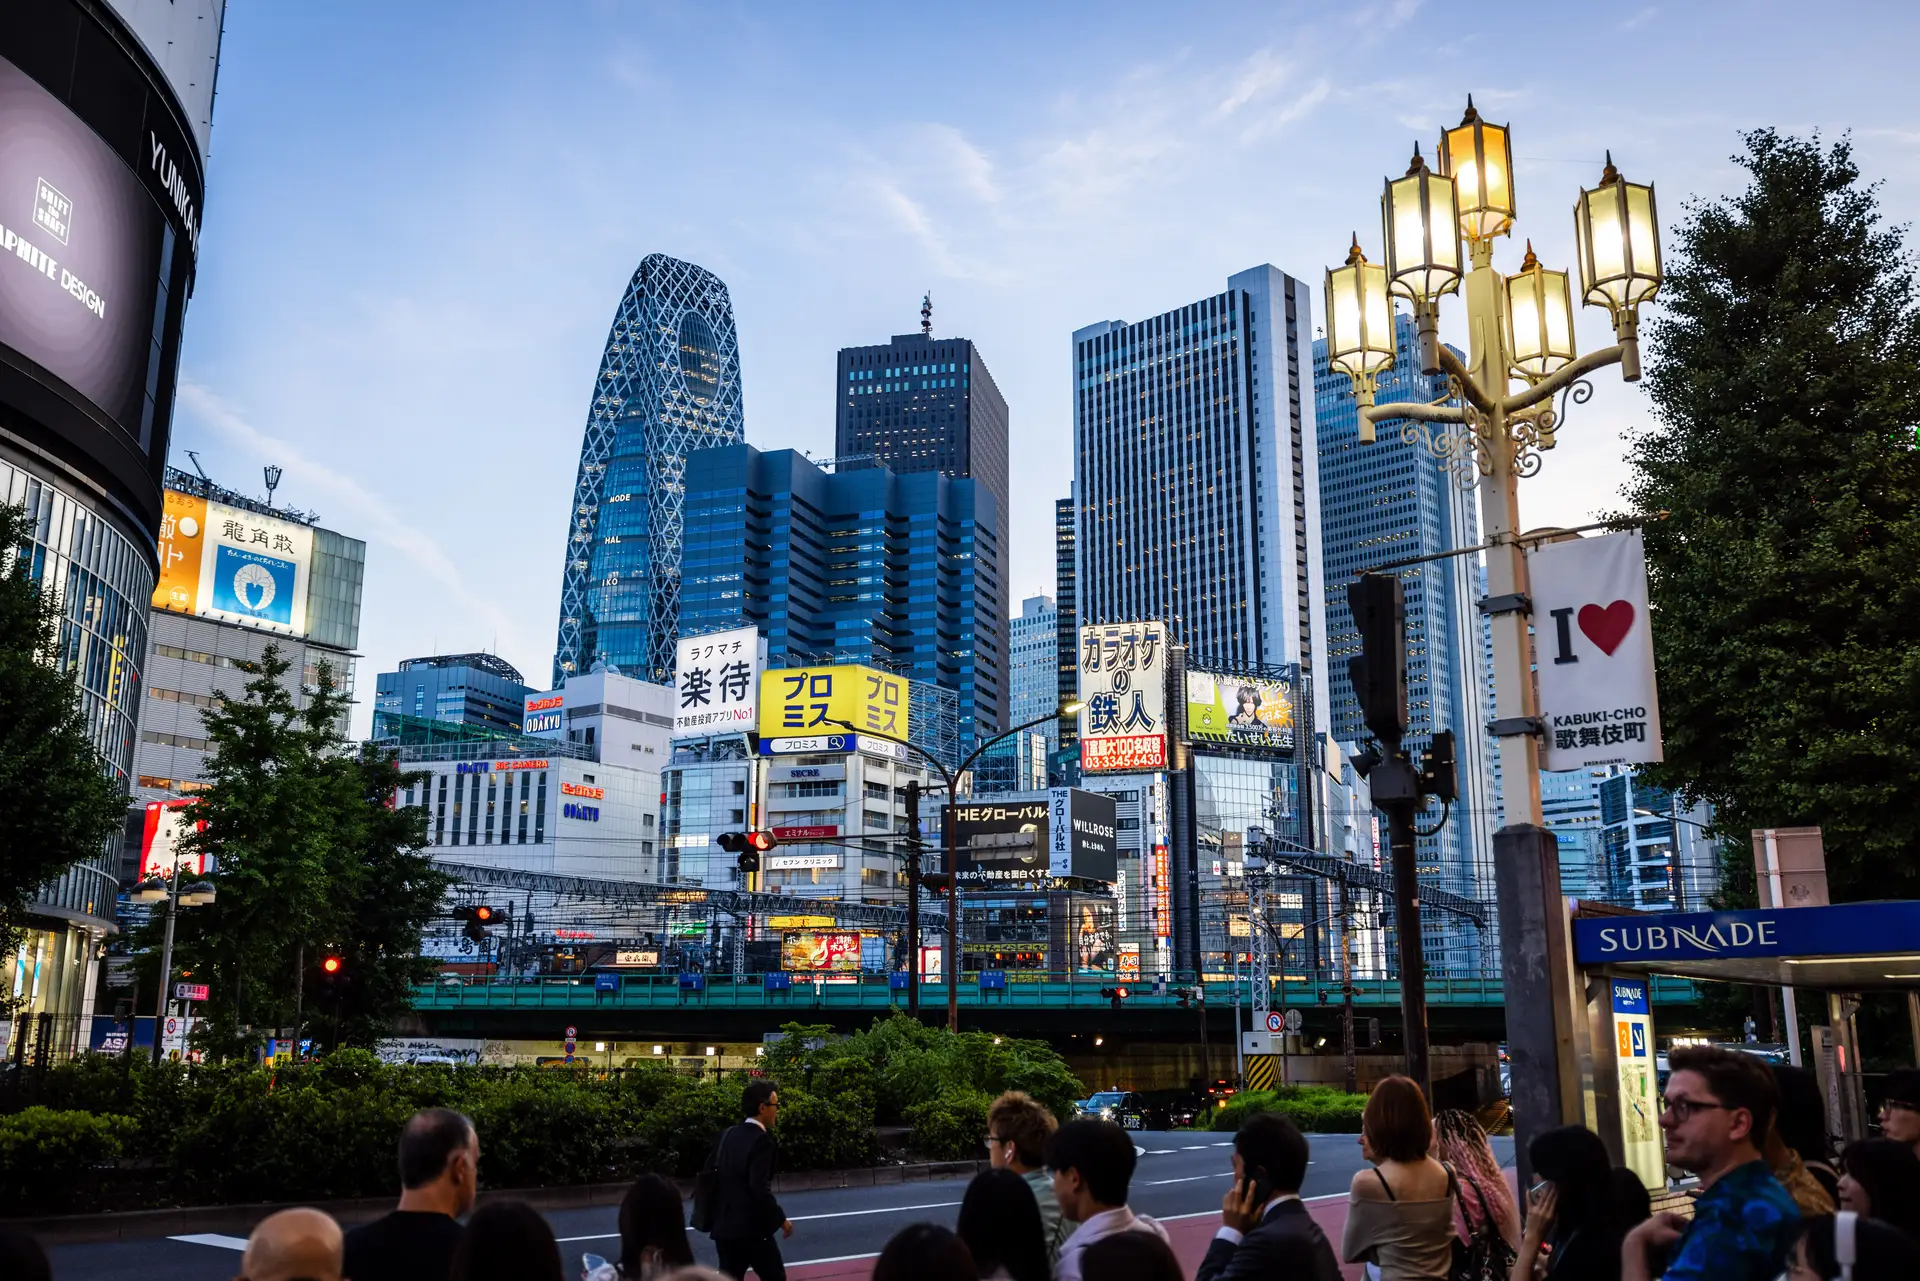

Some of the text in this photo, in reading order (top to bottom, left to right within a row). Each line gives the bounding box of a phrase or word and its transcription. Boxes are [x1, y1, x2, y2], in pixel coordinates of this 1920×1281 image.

[40, 185, 69, 216] SHIFT
[37, 207, 66, 238] SHAFT
[60, 267, 106, 319] DESIGN
[609, 493, 631, 503] MODE
[222, 519, 295, 555] 龍角散
[604, 535, 621, 545] HAL
[1550, 606, 1579, 665] I
[690, 640, 742, 661] ラクマチ
[1081, 623, 1161, 674] カラオケ
[680, 659, 751, 709] 楽待
[783, 671, 833, 701] プロ
[866, 675, 899, 707] プロ
[1111, 667, 1132, 696] の
[525, 695, 564, 713] ビックカメラ
[1087, 689, 1156, 735] 鉄人
[526, 713, 561, 733] ODAKYU
[783, 703, 833, 729] ミス
[866, 704, 898, 735] ミス
[1553, 706, 1647, 728] KABUKI-CHO
[784, 739, 818, 750] プロミス
[1226, 730, 1294, 748] たいせい先生
[1555, 721, 1647, 751] 歌舞伎町
[867, 740, 889, 754] プロミス
[456, 761, 489, 774] ODAKYU
[495, 759, 549, 771] BIC CAMERA
[1085, 753, 1162, 769] 03-3345-6430
[790, 768, 820, 778] SECRE
[561, 782, 605, 801] ビックカメラ
[563, 802, 600, 823] ODAKYU
[1051, 790, 1068, 851] THEグローバル社
[1073, 818, 1115, 839] WILLROSE
[803, 858, 833, 866] クリニック
[1599, 919, 1778, 953] SUBNADE
[1614, 985, 1643, 1000] SUBNADE
[1621, 1030, 1629, 1050] 3
